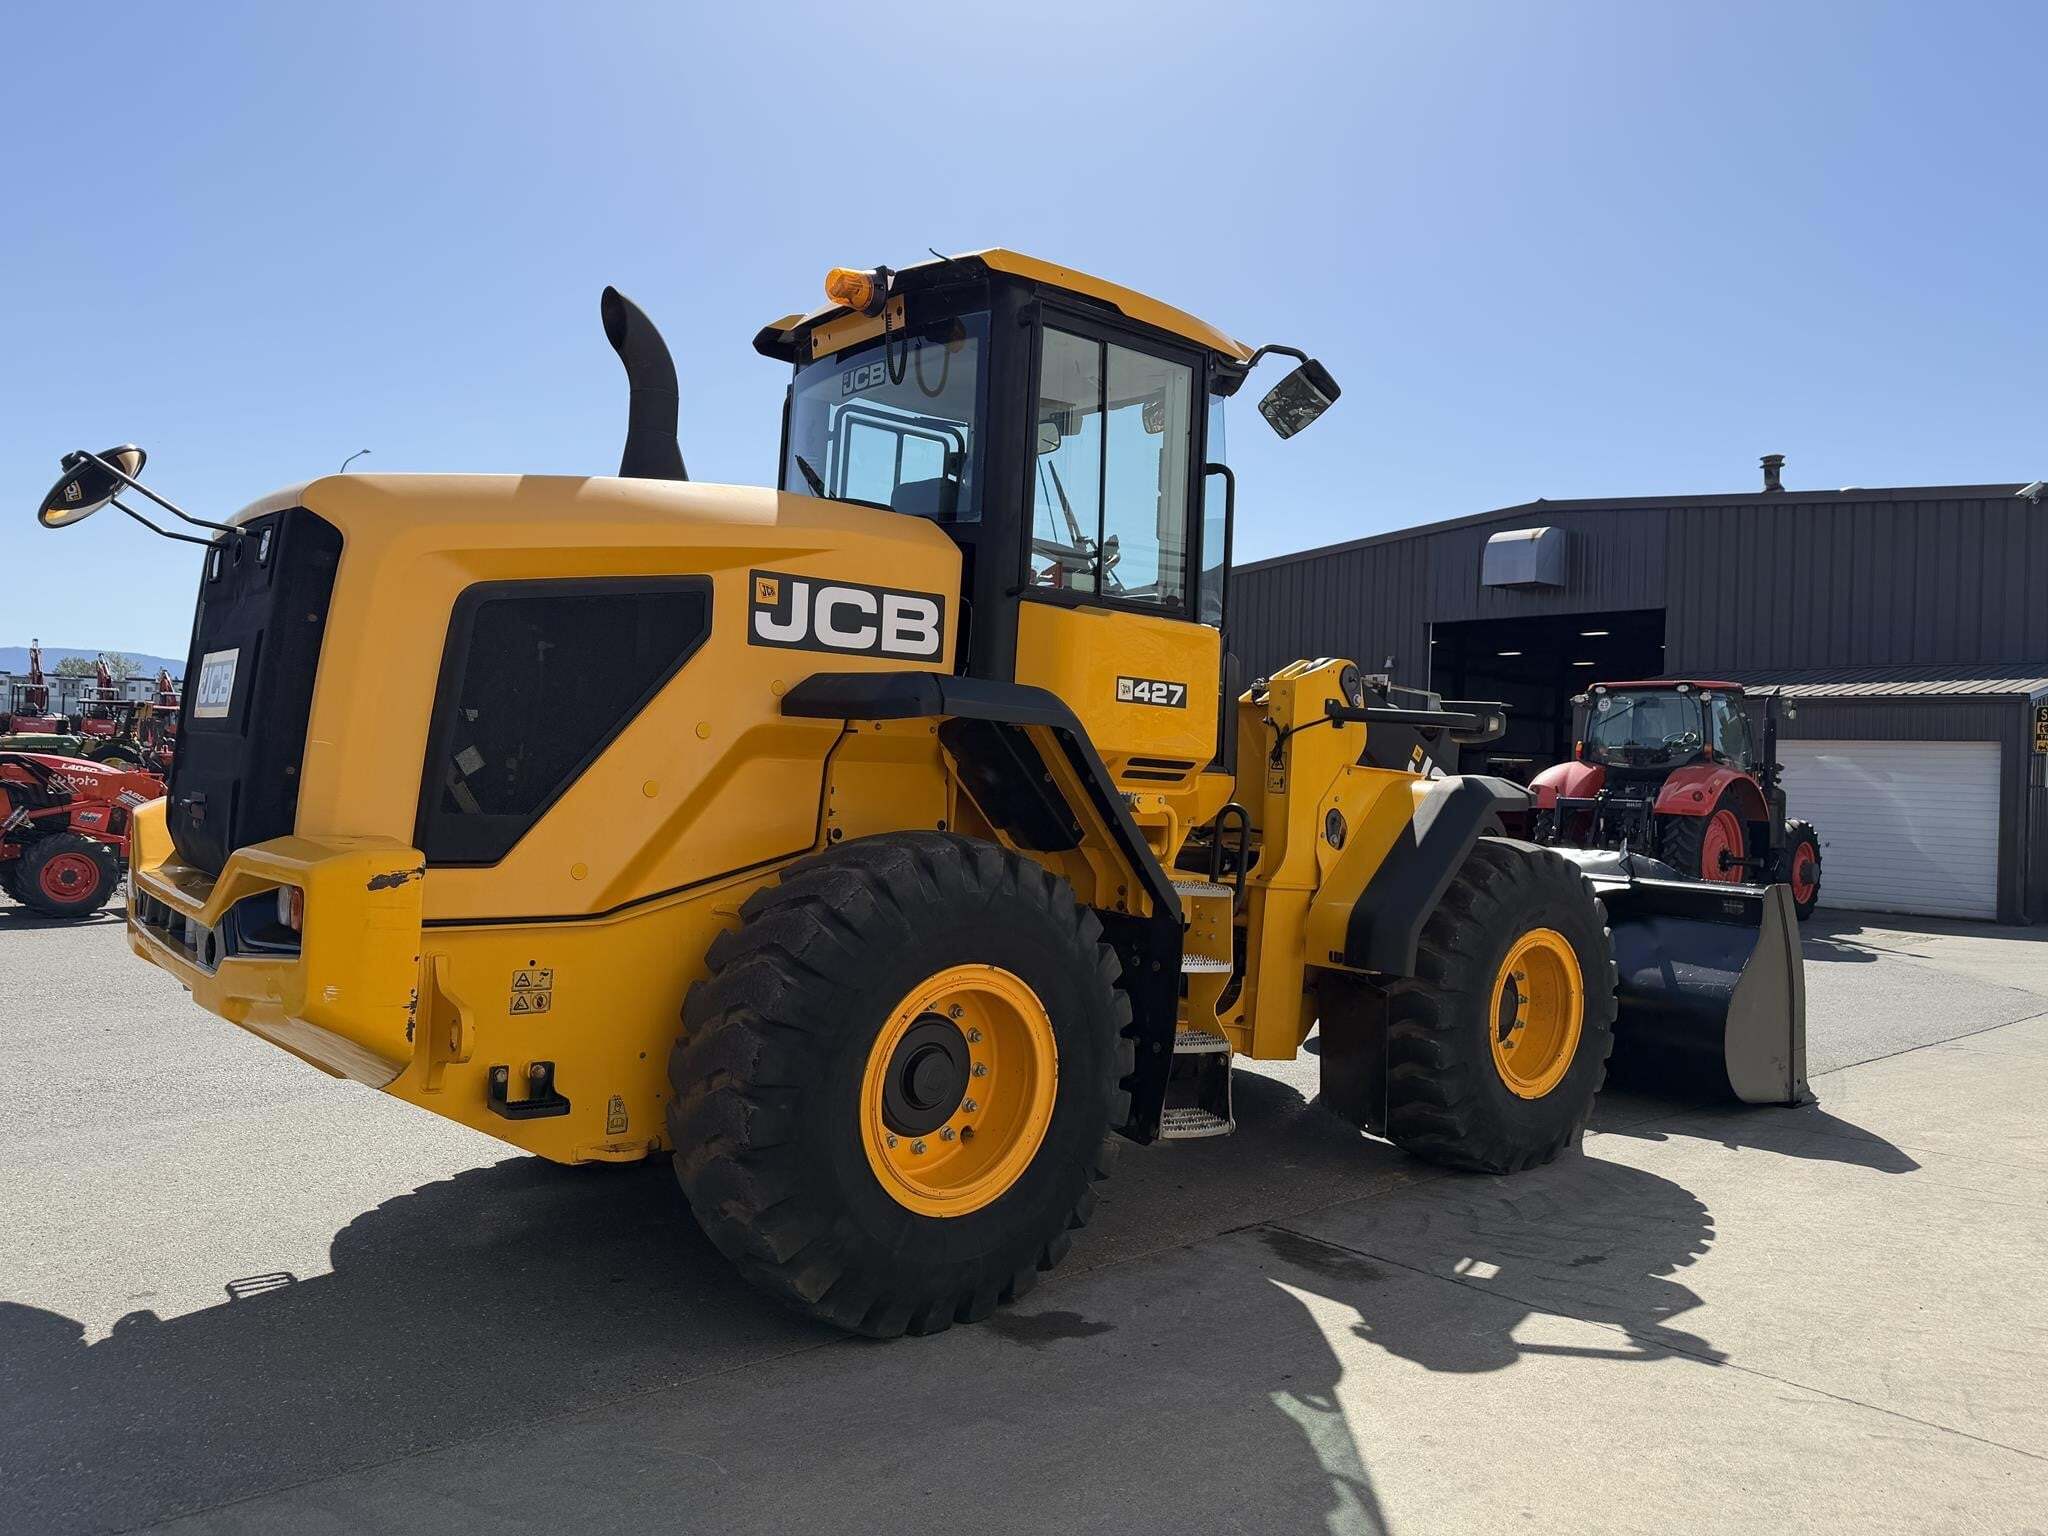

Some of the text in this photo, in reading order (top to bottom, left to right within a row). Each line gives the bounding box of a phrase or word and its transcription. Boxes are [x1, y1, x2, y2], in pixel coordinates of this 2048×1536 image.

[842, 361, 886, 395] JCB
[754, 581, 940, 656] JCB
[1134, 681, 1184, 705] 427
